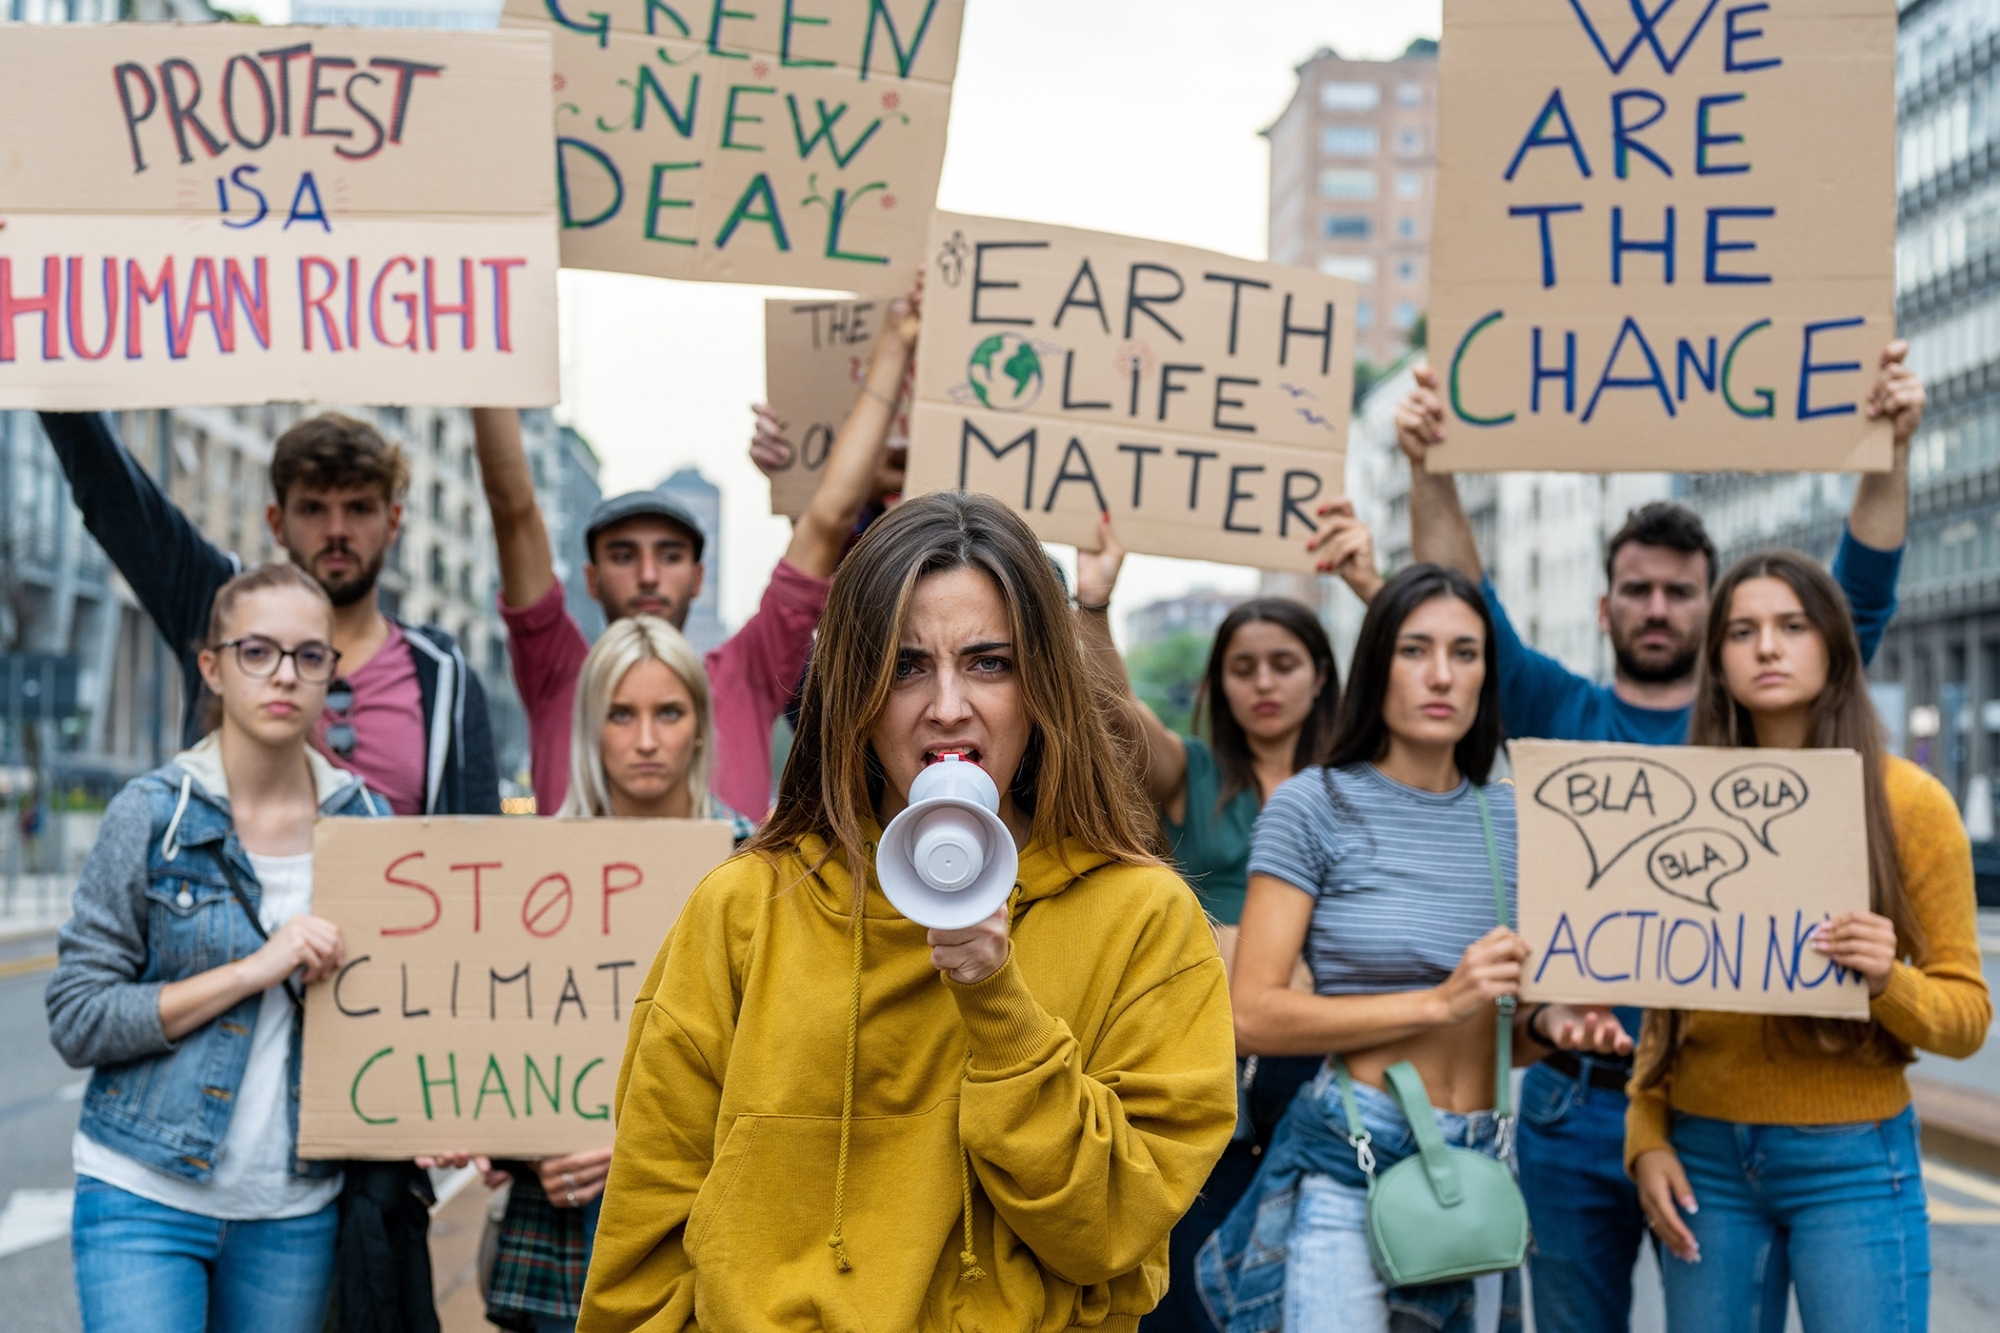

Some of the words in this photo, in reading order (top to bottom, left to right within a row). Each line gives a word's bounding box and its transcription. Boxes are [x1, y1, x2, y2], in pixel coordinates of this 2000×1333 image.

[1568, 0, 1783, 74] WE
[114, 43, 446, 173] PROTEST
[632, 64, 882, 169] NEW
[1503, 87, 1751, 181] ARE
[216, 164, 268, 229] IS
[282, 171, 331, 232] A
[556, 137, 890, 264] DEAL
[1508, 204, 1776, 288] THE
[0, 254, 271, 361] HUMAN
[298, 255, 527, 353] RIGHT
[789, 302, 876, 351] THE
[970, 242, 1336, 376] EARTH
[1449, 310, 1866, 427] CHANGE
[959, 419, 1323, 538] MATTER
[1566, 767, 1657, 816] BLA
[1732, 777, 1798, 809] BLA
[380, 851, 643, 938] STOP
[1658, 842, 1727, 880] BLA
[333, 955, 637, 1026] CLIMAT
[1533, 910, 1744, 991] ACTION
[350, 1047, 611, 1126] CHANG
